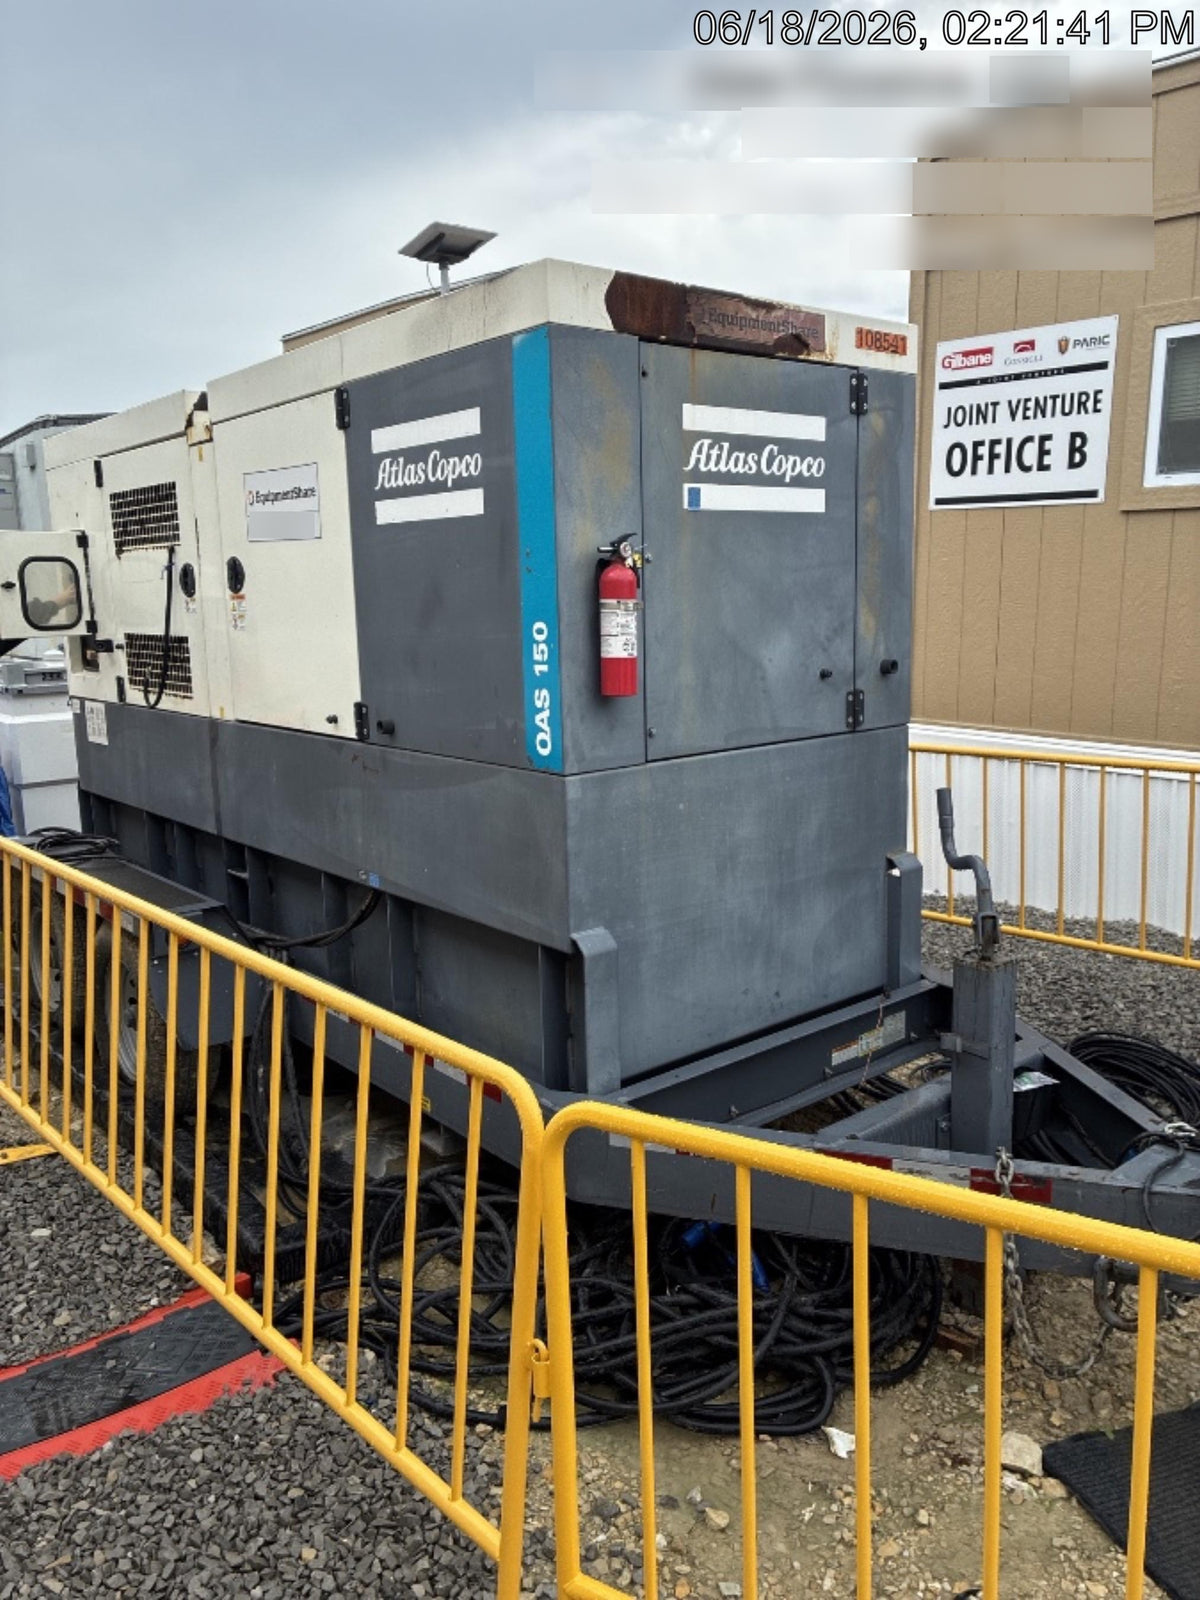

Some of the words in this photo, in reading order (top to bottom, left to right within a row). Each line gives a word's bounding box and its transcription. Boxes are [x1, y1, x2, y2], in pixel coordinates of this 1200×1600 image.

[855, 327, 907, 355] 108541
[942, 352, 992, 370] Gilbane
[1072, 335, 1110, 349] PARIC
[943, 401, 1000, 429] JOINT
[1007, 389, 1103, 422] VENTURE
[374, 457, 426, 491] Atlas
[427, 449, 482, 488] Copco
[682, 438, 758, 475] Atlas
[760, 444, 826, 483] Copco
[945, 433, 1053, 477] OFFICE
[1067, 431, 1088, 469] B
[532, 621, 549, 677] 150
[535, 688, 551, 756] QAS
